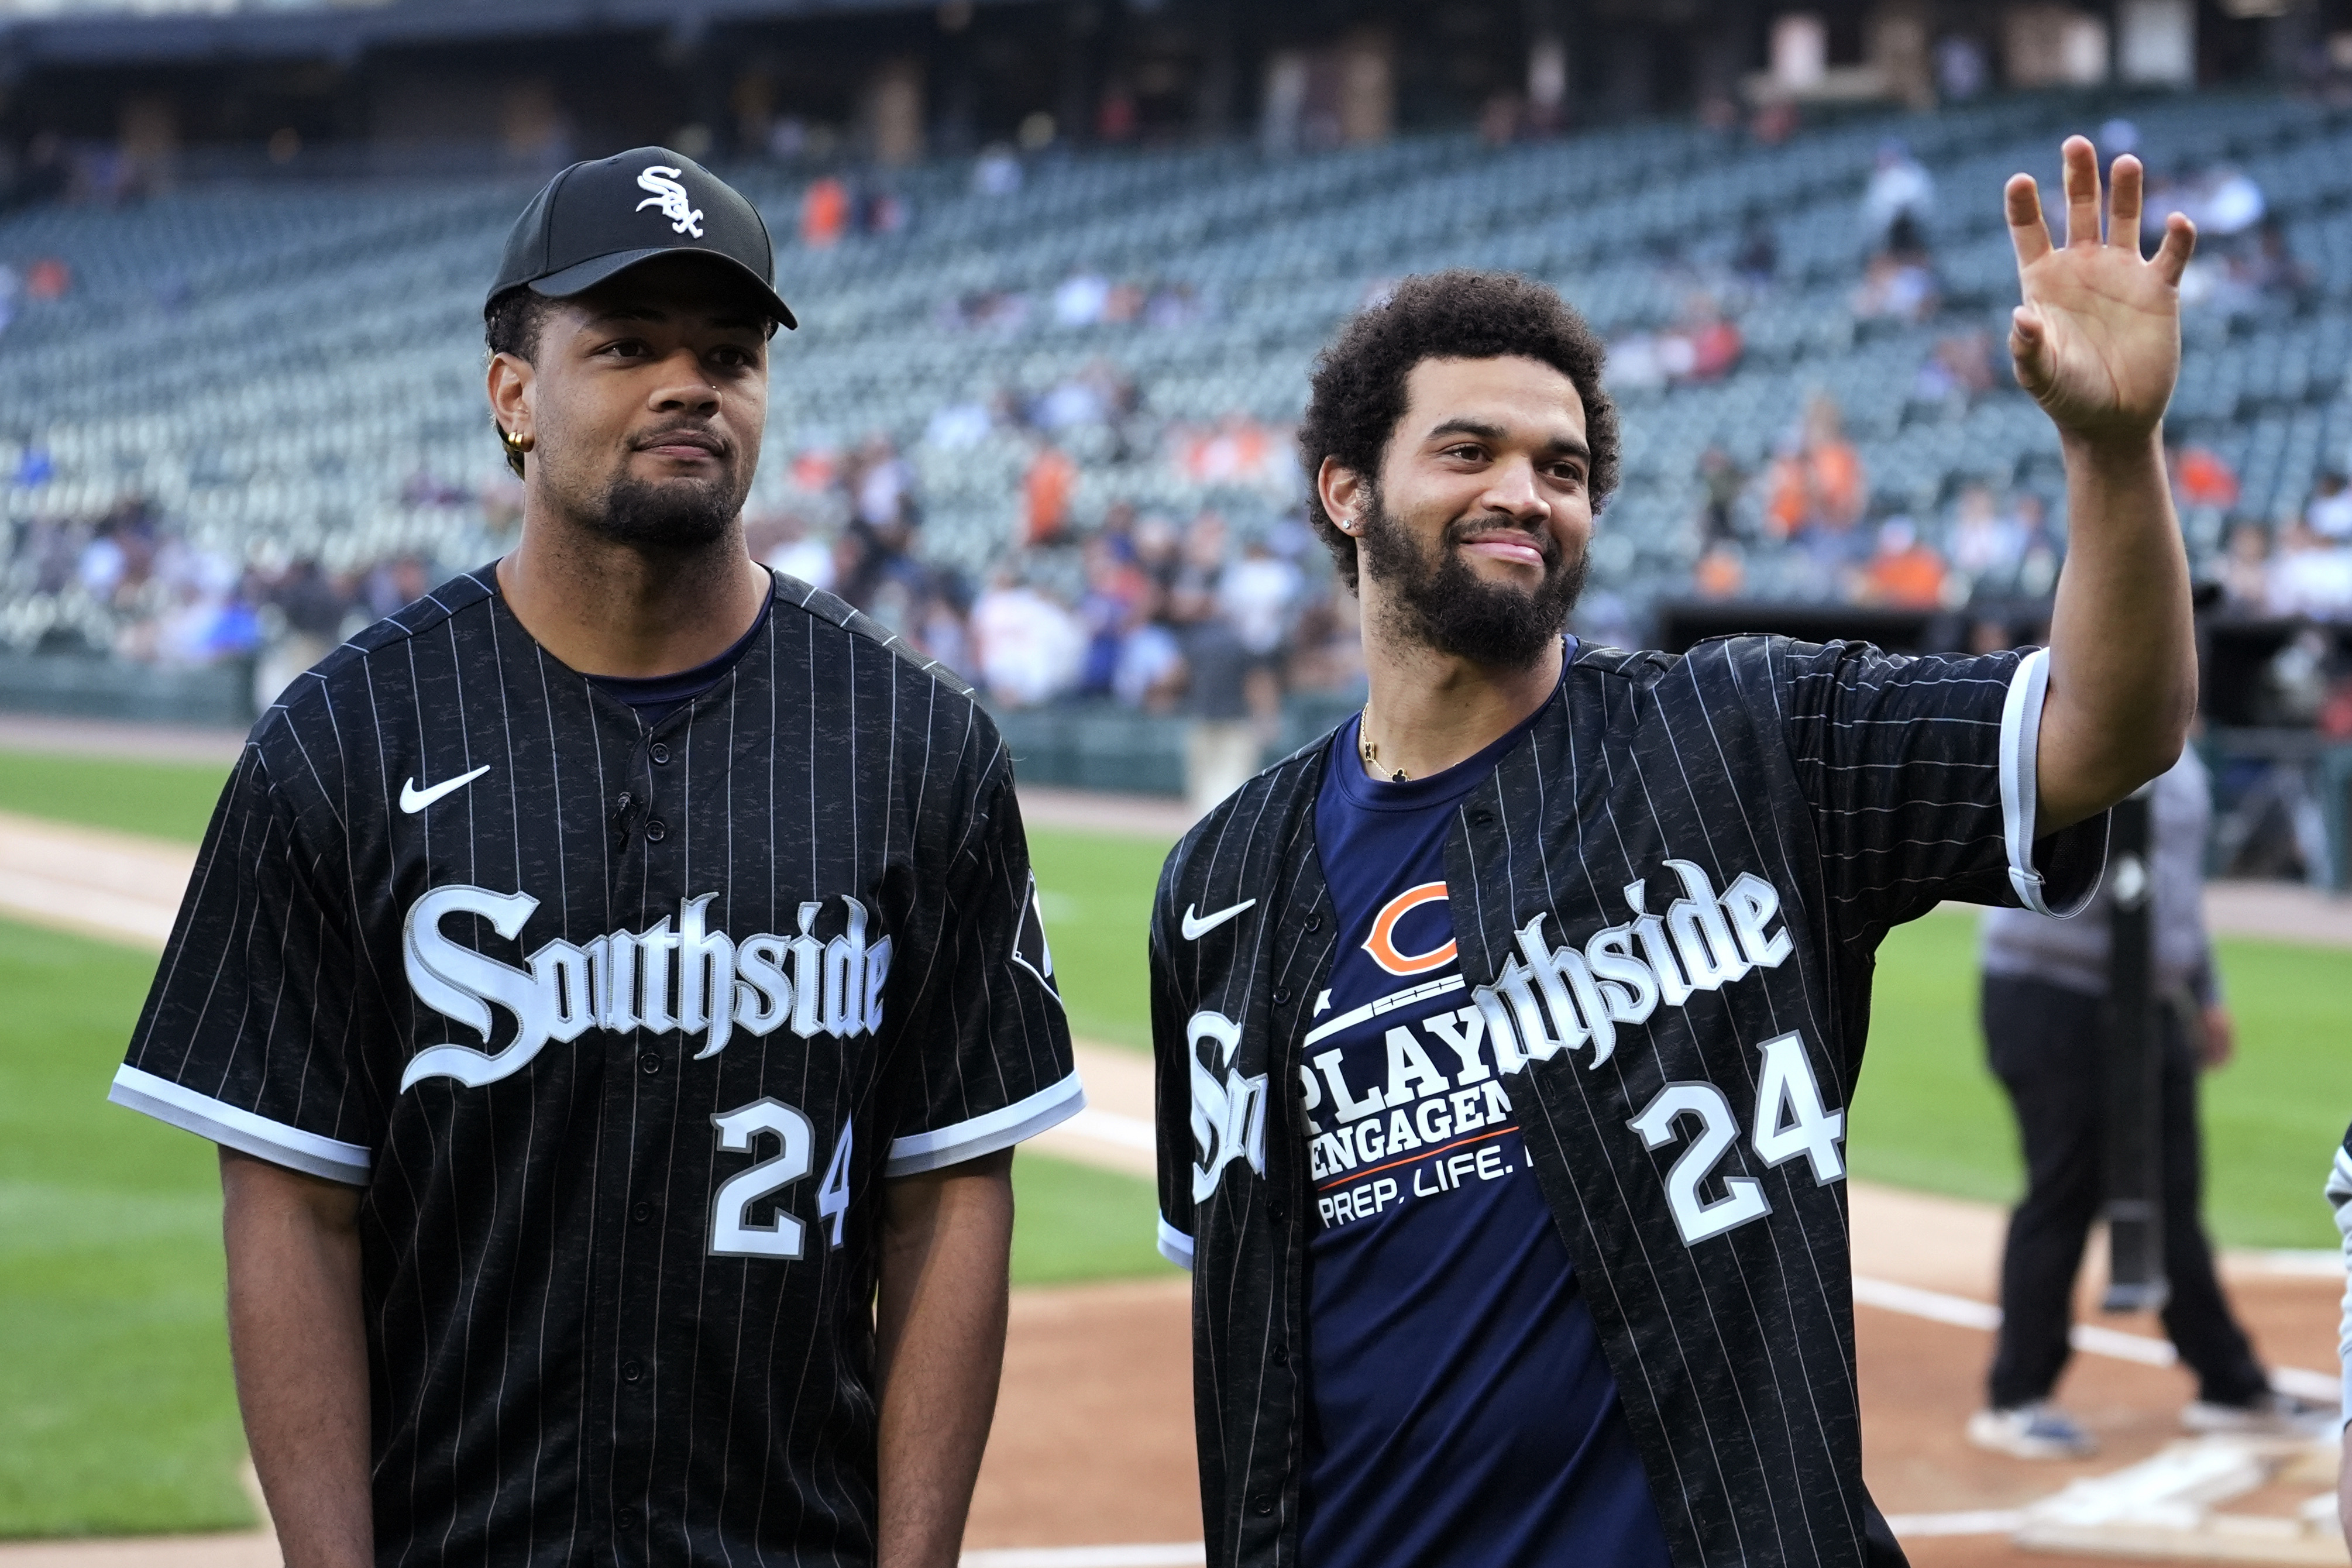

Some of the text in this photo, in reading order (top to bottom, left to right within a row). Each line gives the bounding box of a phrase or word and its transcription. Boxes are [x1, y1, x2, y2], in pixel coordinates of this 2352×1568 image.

[635, 166, 703, 239] Sox
[400, 884, 893, 1094] Southside
[1361, 881, 1458, 976] C
[707, 1096, 852, 1260] 24
[1414, 1144, 1514, 1198] LIFE.
[1627, 1029, 1845, 1247] 24
